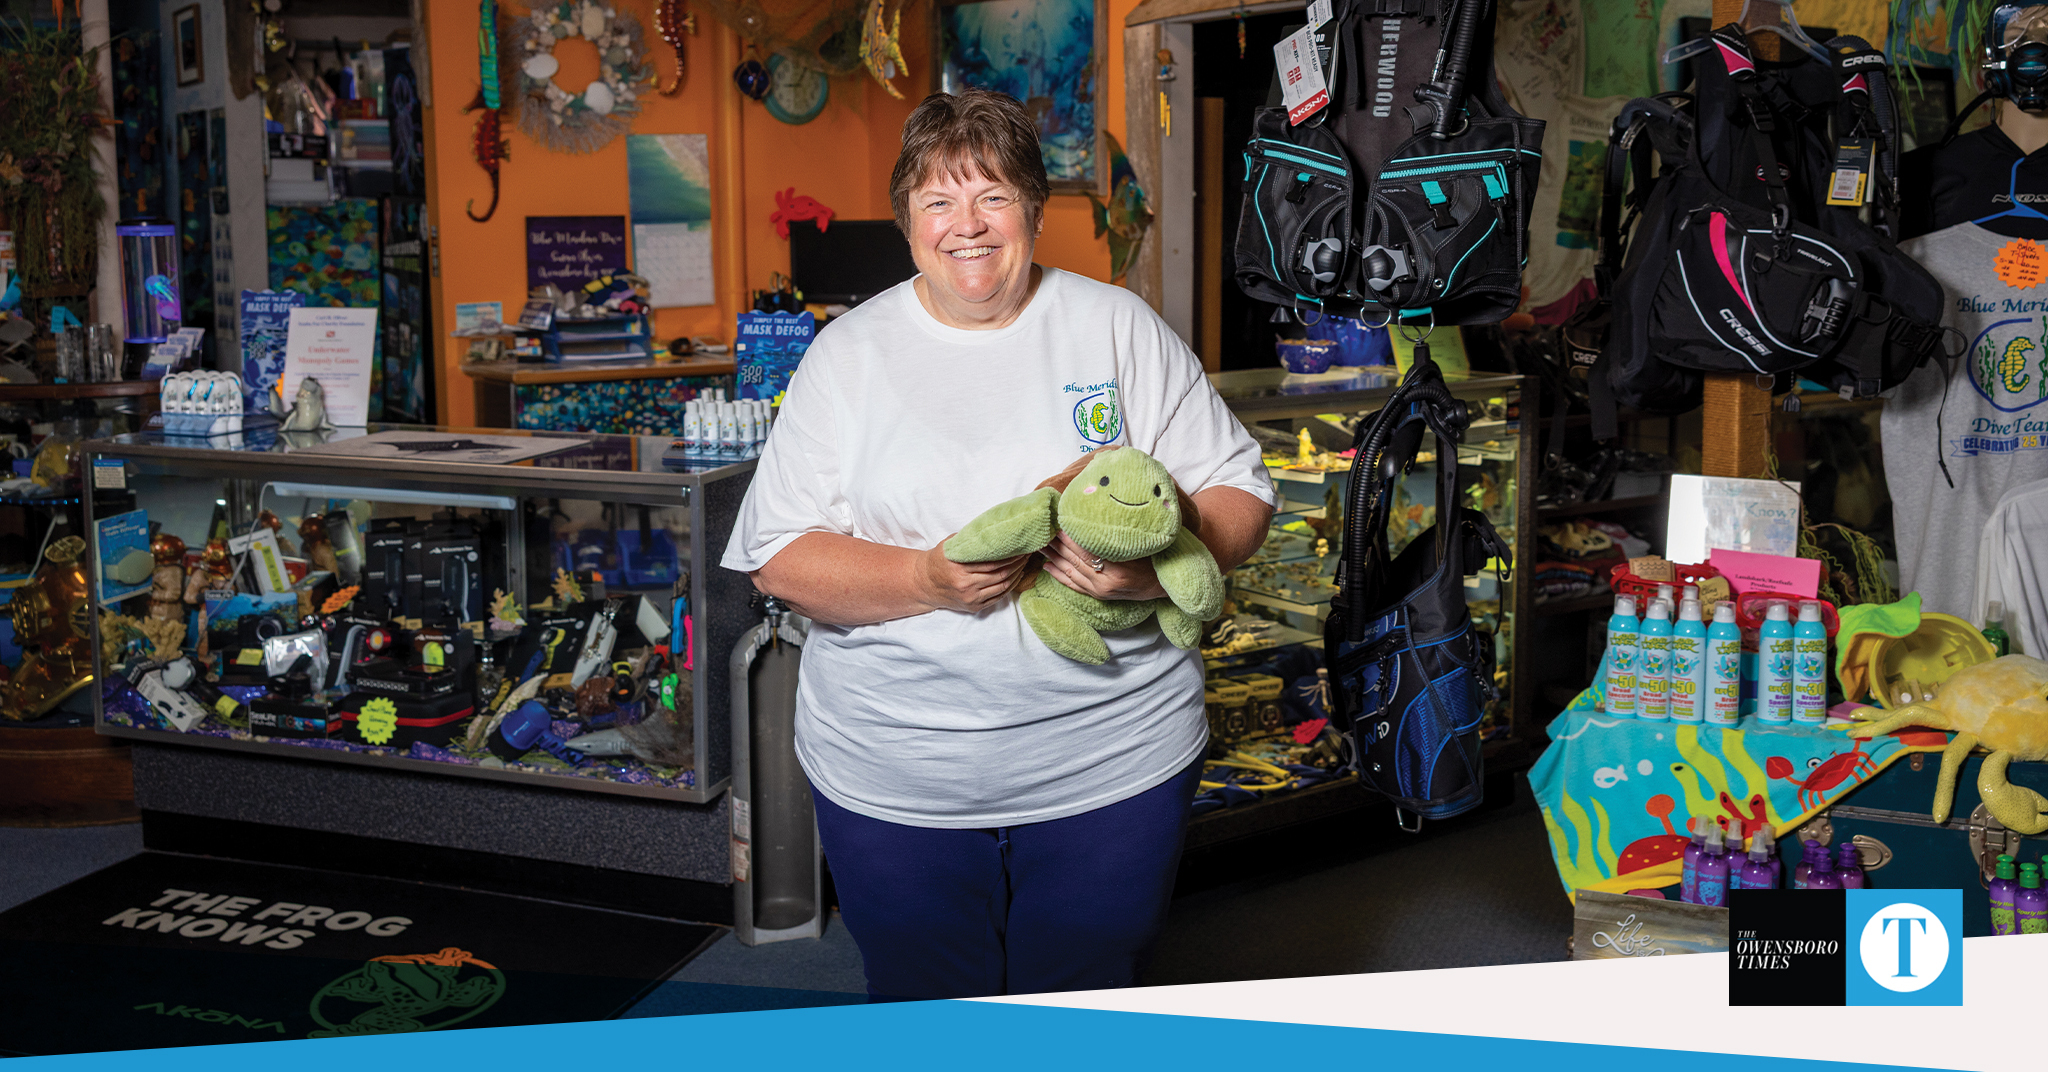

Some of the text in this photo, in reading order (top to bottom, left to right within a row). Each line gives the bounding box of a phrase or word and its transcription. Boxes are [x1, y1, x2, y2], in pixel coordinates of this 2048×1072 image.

[246, 302, 271, 313] MASK
[1956, 294, 1997, 313] Blue
[742, 324, 810, 336] MASK DEFOG
[1719, 308, 1773, 357] CRESSI
[740, 364, 763, 377] 500
[1063, 382, 1085, 394] Blue
[1971, 416, 2012, 436] Dive
[1963, 434, 2048, 453] CELEBRATIG 25 Y
[1743, 502, 1798, 519] Know?
[1750, 582, 1777, 590] Products
[150, 888, 414, 938] THE FROG
[102, 907, 317, 950] KNOWS
[1592, 913, 1655, 956] Life
